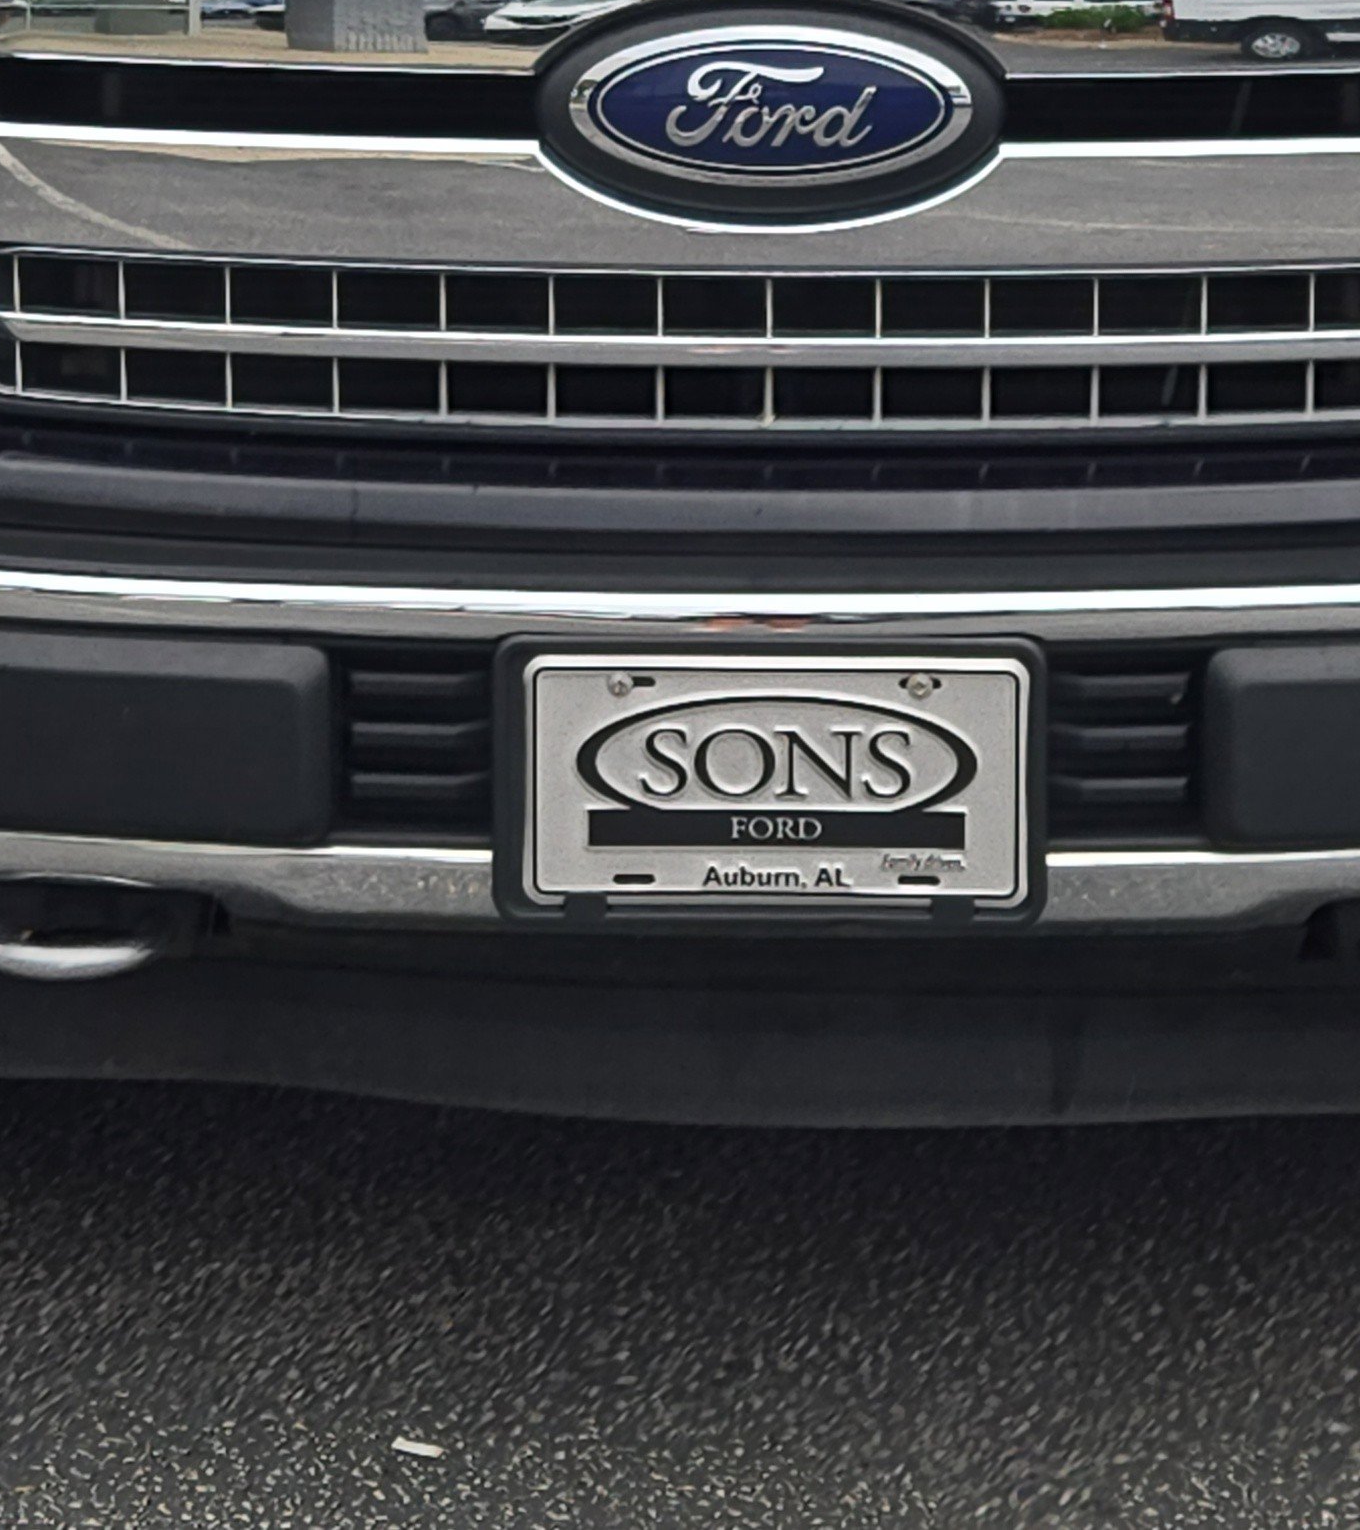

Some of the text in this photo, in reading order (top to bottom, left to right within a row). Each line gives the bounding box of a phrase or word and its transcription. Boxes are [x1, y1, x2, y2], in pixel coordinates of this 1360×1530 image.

[665, 60, 878, 149] Ford
[639, 726, 912, 799] SONS
[730, 816, 823, 841] FORD
[702, 866, 853, 889] Auburn, AL
